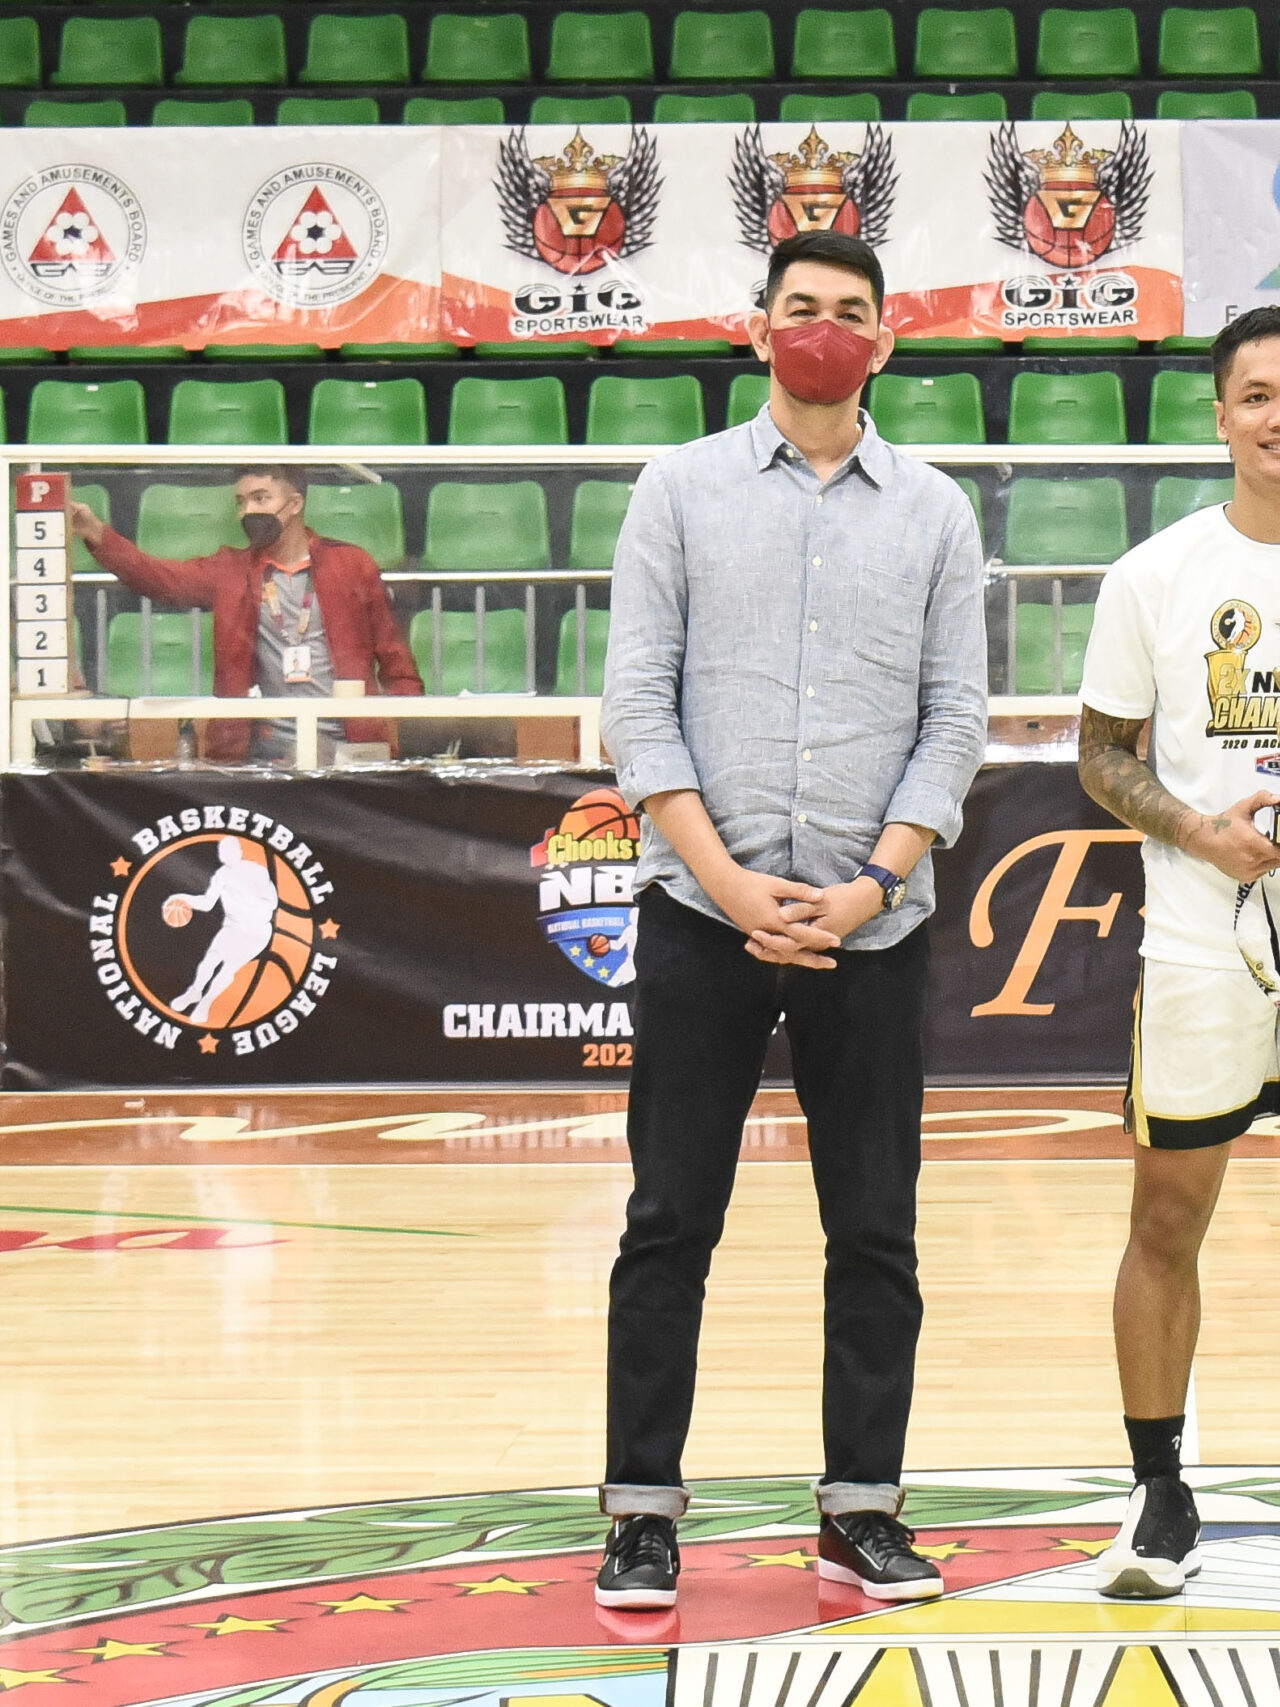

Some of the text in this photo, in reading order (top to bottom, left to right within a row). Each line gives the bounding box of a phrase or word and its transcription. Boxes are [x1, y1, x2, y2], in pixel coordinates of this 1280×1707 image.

[3, 168, 143, 263] GAMES AND AMUSEMENTS BOARD
[246, 167, 385, 260] GAMES AND AMUSEMENTS BOARD
[514, 314, 643, 333] SPORTSWEAR
[1004, 309, 1135, 327] SPORTSWEAR
[30, 480, 51, 503] P
[33, 520, 47, 541] 5
[33, 557, 47, 578] 4
[35, 594, 48, 614] 3
[35, 631, 48, 651] 2
[36, 668, 47, 688] 1
[131, 805, 335, 905] BASKETBALL
[547, 830, 634, 867] Chooks
[540, 865, 637, 912] NB
[90, 892, 183, 1050] NATIONAL
[231, 951, 339, 1057] LEAGUE
[443, 1003, 635, 1038] CHAIRMA
[582, 1043, 634, 1068] 202
